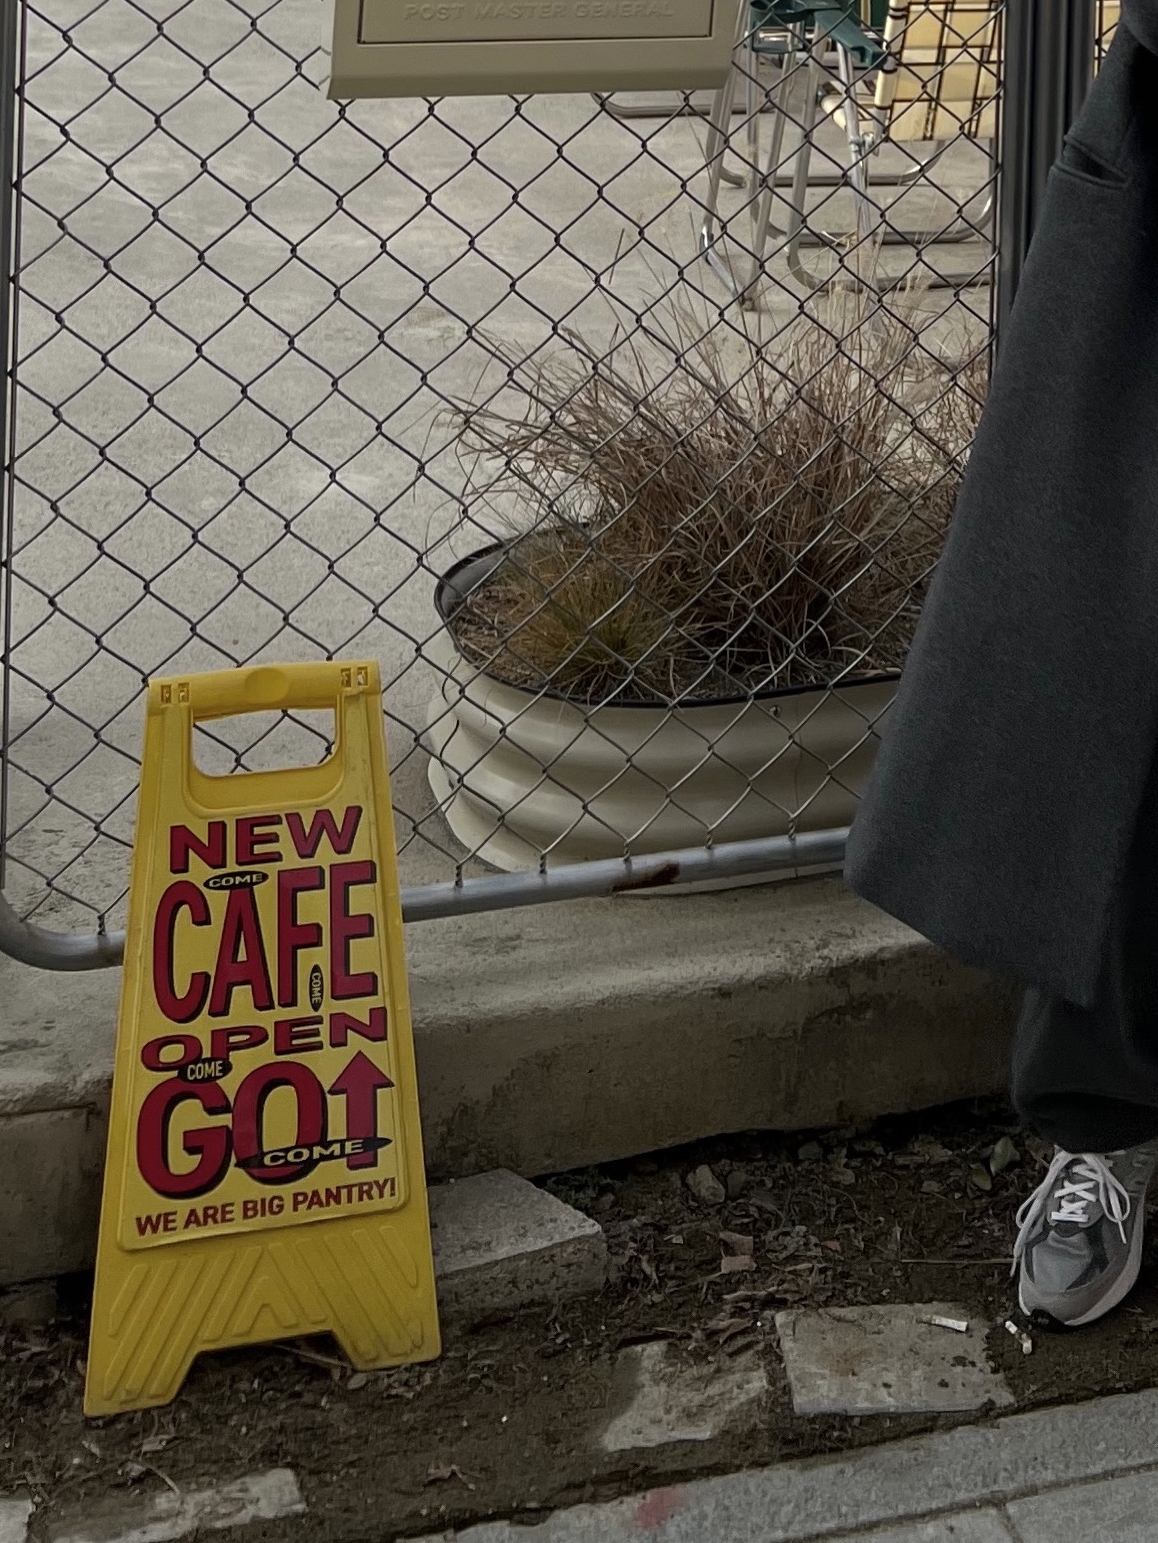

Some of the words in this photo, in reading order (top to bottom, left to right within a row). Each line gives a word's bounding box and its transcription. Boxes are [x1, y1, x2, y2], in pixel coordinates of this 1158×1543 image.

[403, 3, 465, 21] POST
[474, 2, 567, 20] MASTER
[575, 0, 675, 18] GENERAL
[169, 805, 364, 875] NEW
[207, 872, 264, 888] COME
[152, 860, 380, 1025] CAFE
[311, 972, 322, 1005] COME
[140, 1006, 388, 1073] OPEN
[186, 1059, 224, 1081] COME
[262, 1139, 364, 1167] COME
[135, 1212, 178, 1238] WE
[182, 1203, 236, 1231] ARE
[242, 1196, 285, 1221] BIG
[292, 1177, 397, 1212] PANTRY!
